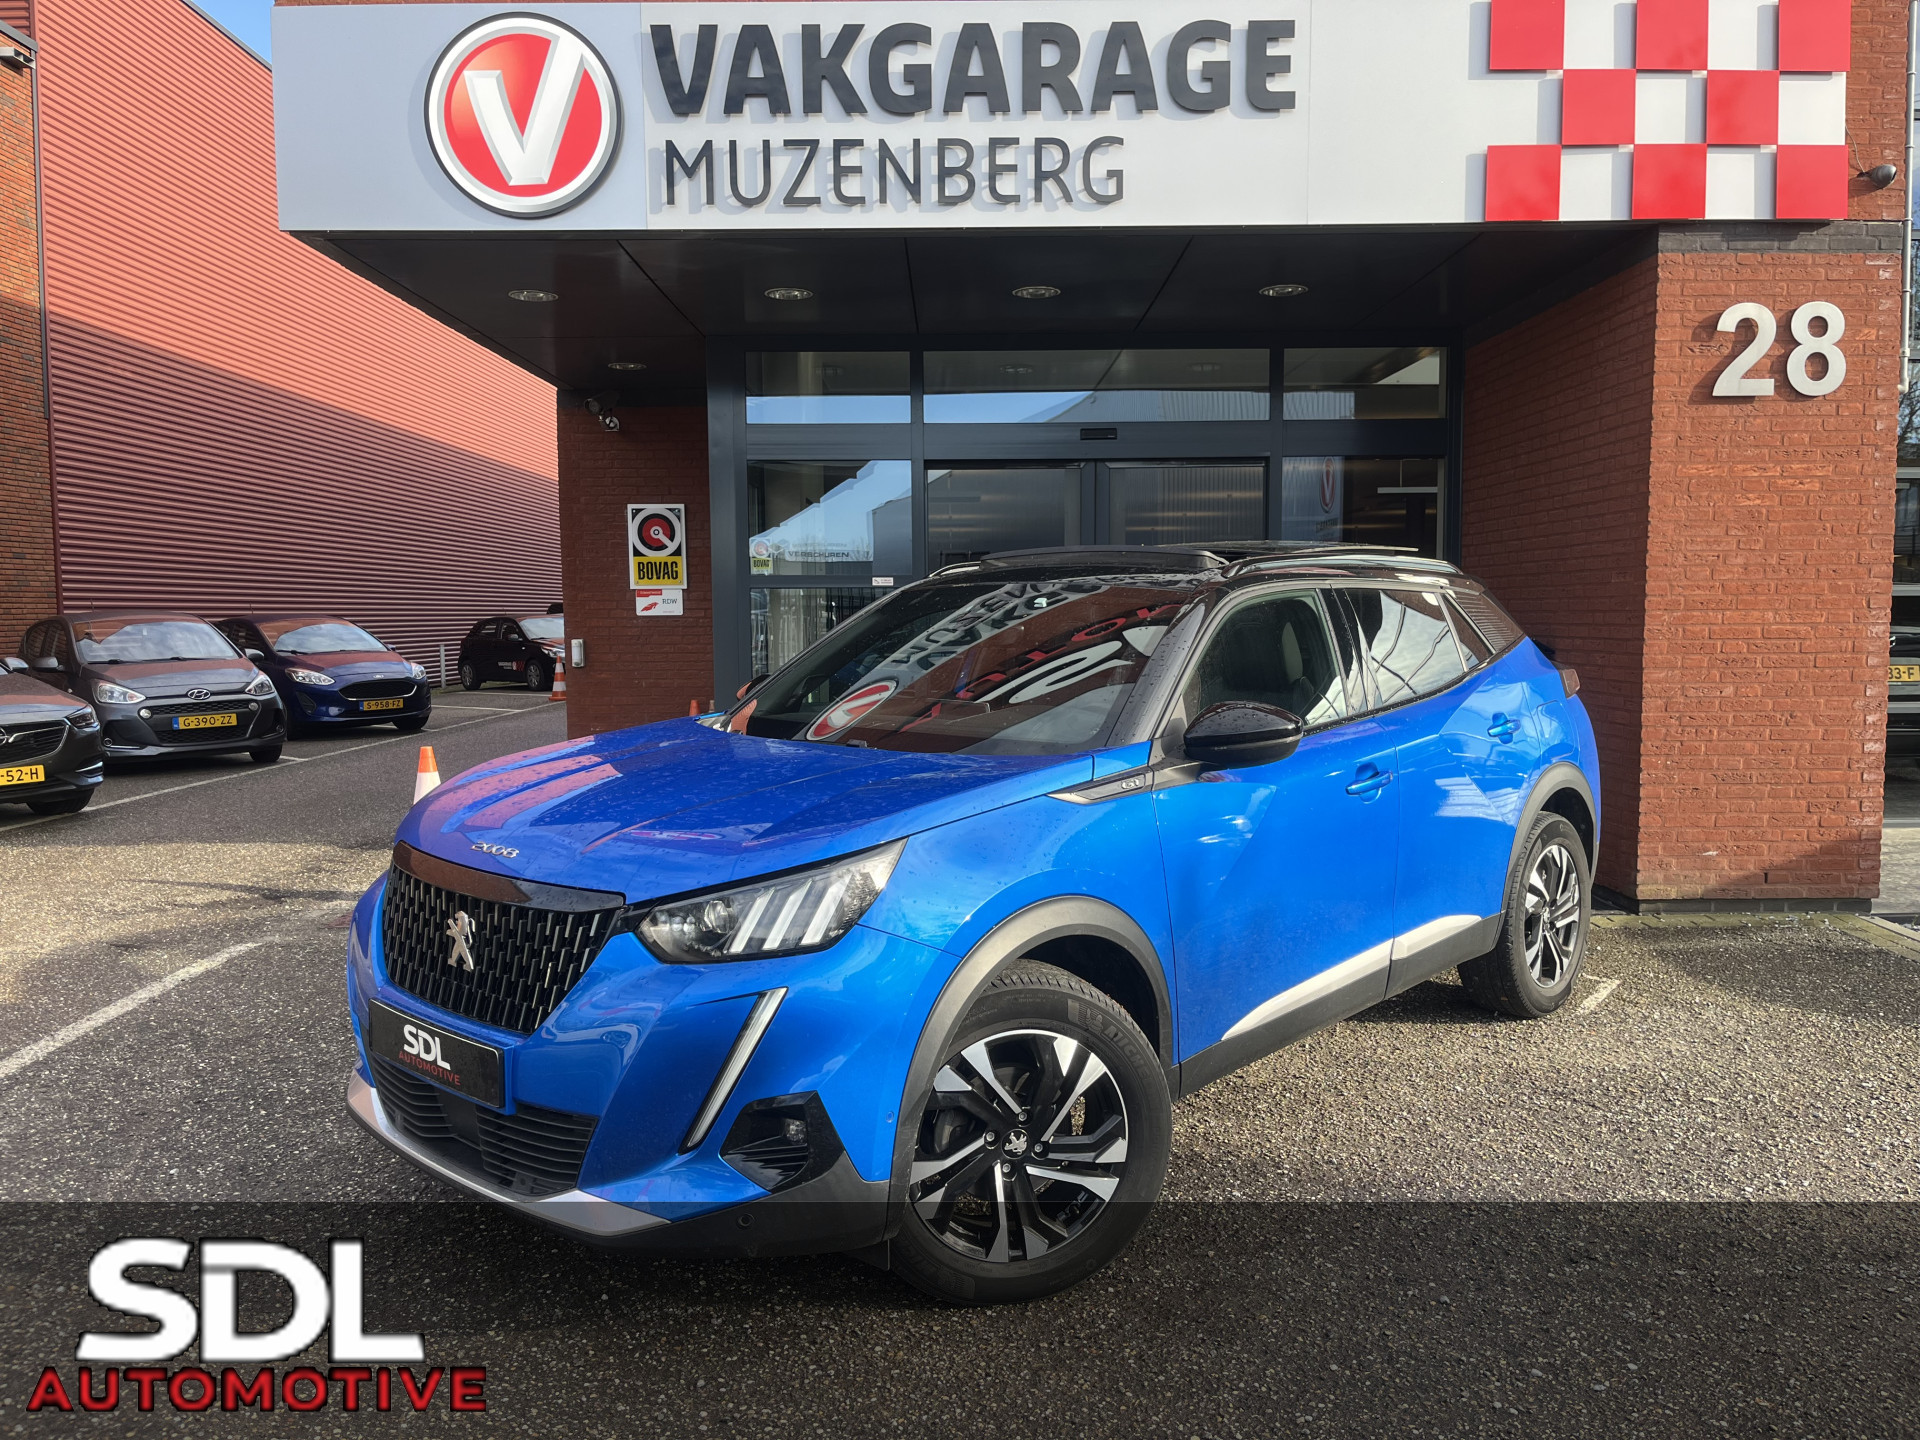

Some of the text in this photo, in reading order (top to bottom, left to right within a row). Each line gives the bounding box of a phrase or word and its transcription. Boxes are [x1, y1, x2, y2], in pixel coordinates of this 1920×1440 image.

[650, 19, 1296, 115] VAKGARAGE
[463, 30, 588, 187] V
[665, 136, 1124, 206] MUZENBERG
[1712, 301, 1847, 397] 28
[638, 561, 679, 580] BOVAG
[753, 559, 770, 568] BOVAG
[183, 715, 233, 727] G-390-ZZ
[366, 700, 401, 710] S-958-FZ
[471, 840, 520, 859] 2008
[403, 1024, 451, 1071] SDL
[398, 1050, 461, 1086] AUTOMOTIVE
